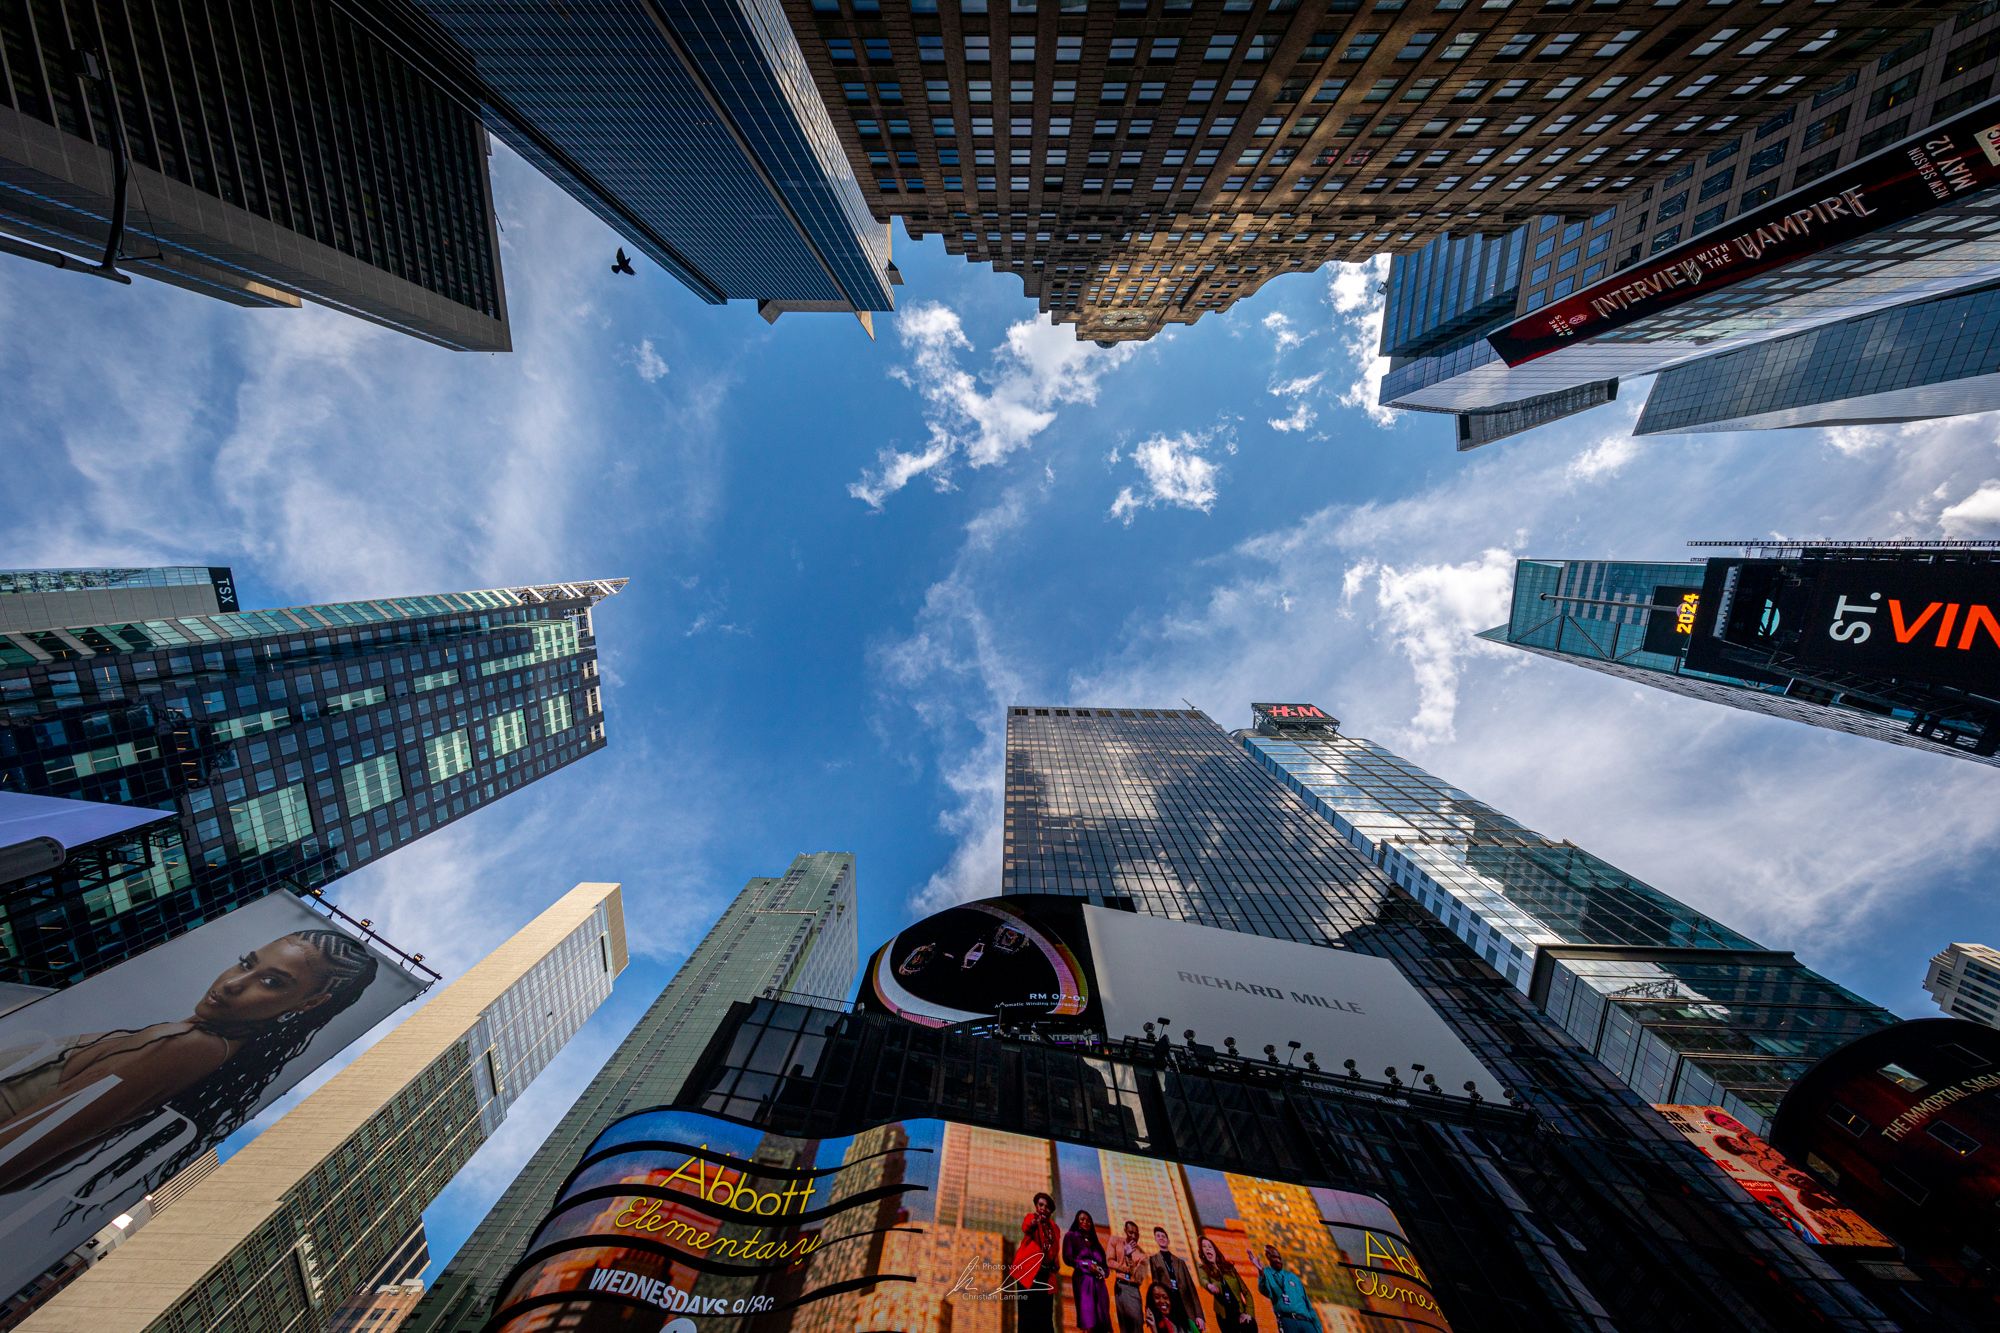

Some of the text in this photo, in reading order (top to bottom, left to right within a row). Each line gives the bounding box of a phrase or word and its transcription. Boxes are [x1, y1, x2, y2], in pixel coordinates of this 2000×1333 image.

[1907, 147, 1950, 199] NEW SEASON
[1925, 135, 1978, 192] MAY 12
[1733, 184, 1878, 261] VAMPIRE
[1697, 243, 1730, 265] WITH
[1705, 252, 1731, 270] THE
[1590, 258, 1703, 319] INTERVIEW
[1548, 318, 1566, 337] ANNE
[217, 577, 234, 604] TSX
[1676, 593, 1700, 635] 2024
[1829, 591, 1882, 645] ST.
[1051, 993, 1086, 1002] 07-01
[1177, 970, 1367, 1016] RICHARD MILLE
[1881, 1118, 1913, 1143] THE
[1904, 1085, 1972, 1126] IMMORTAL
[659, 1143, 818, 1217] Abbott
[614, 1196, 824, 1266] Elementary
[588, 1268, 728, 1315] WEDNESDAYS
